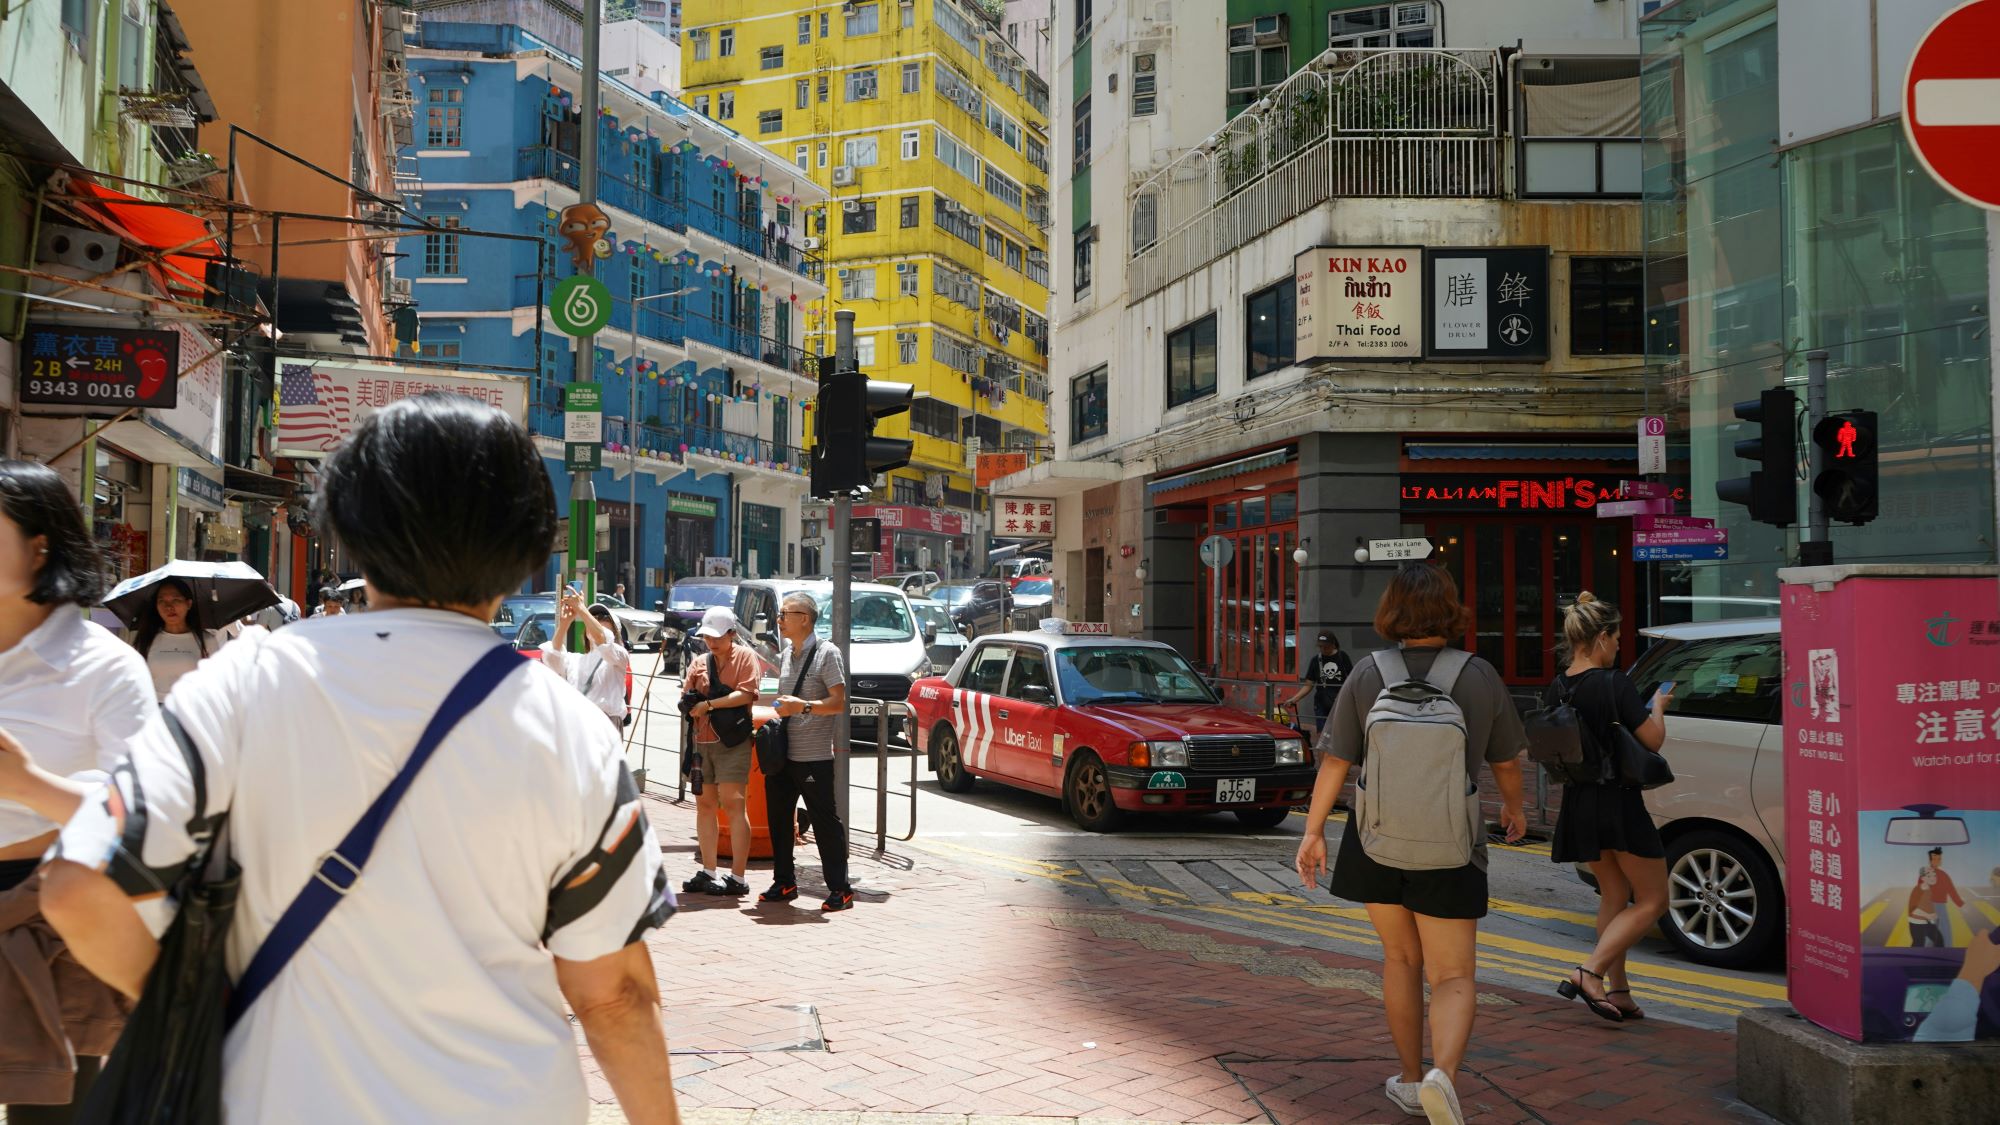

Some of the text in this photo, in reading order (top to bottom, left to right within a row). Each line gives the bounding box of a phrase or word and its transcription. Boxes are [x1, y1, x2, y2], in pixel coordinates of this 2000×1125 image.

[1328, 257, 1407, 273] KIN KAO
[1351, 301, 1384, 320] 食飯
[1336, 324, 1401, 336] Thai Food
[1448, 331, 1476, 339] DRUM
[1357, 340, 1388, 348] Tel:2383
[94, 358, 122, 373] 24H
[29, 380, 136, 398] 9343 0016
[1652, 439, 1660, 454] Chai
[1497, 477, 1598, 509] FINI'S
[1005, 501, 1053, 516] 陳廣記
[1005, 519, 1053, 534] 茶餐廳
[1071, 623, 1108, 633] TAXI
[1895, 678, 1981, 705] 專注駕駛
[1004, 726, 1043, 751] Uber Taxi
[1799, 747, 1845, 762] POST NO BILL
[1912, 754, 1952, 768] Watch
[1953, 752, 1975, 766] out
[1977, 751, 1993, 764] for
[1163, 774, 1172, 783] 4
[1228, 779, 1245, 791] TF
[1219, 790, 1252, 802] 8790
[1825, 791, 1843, 911] 小心過路
